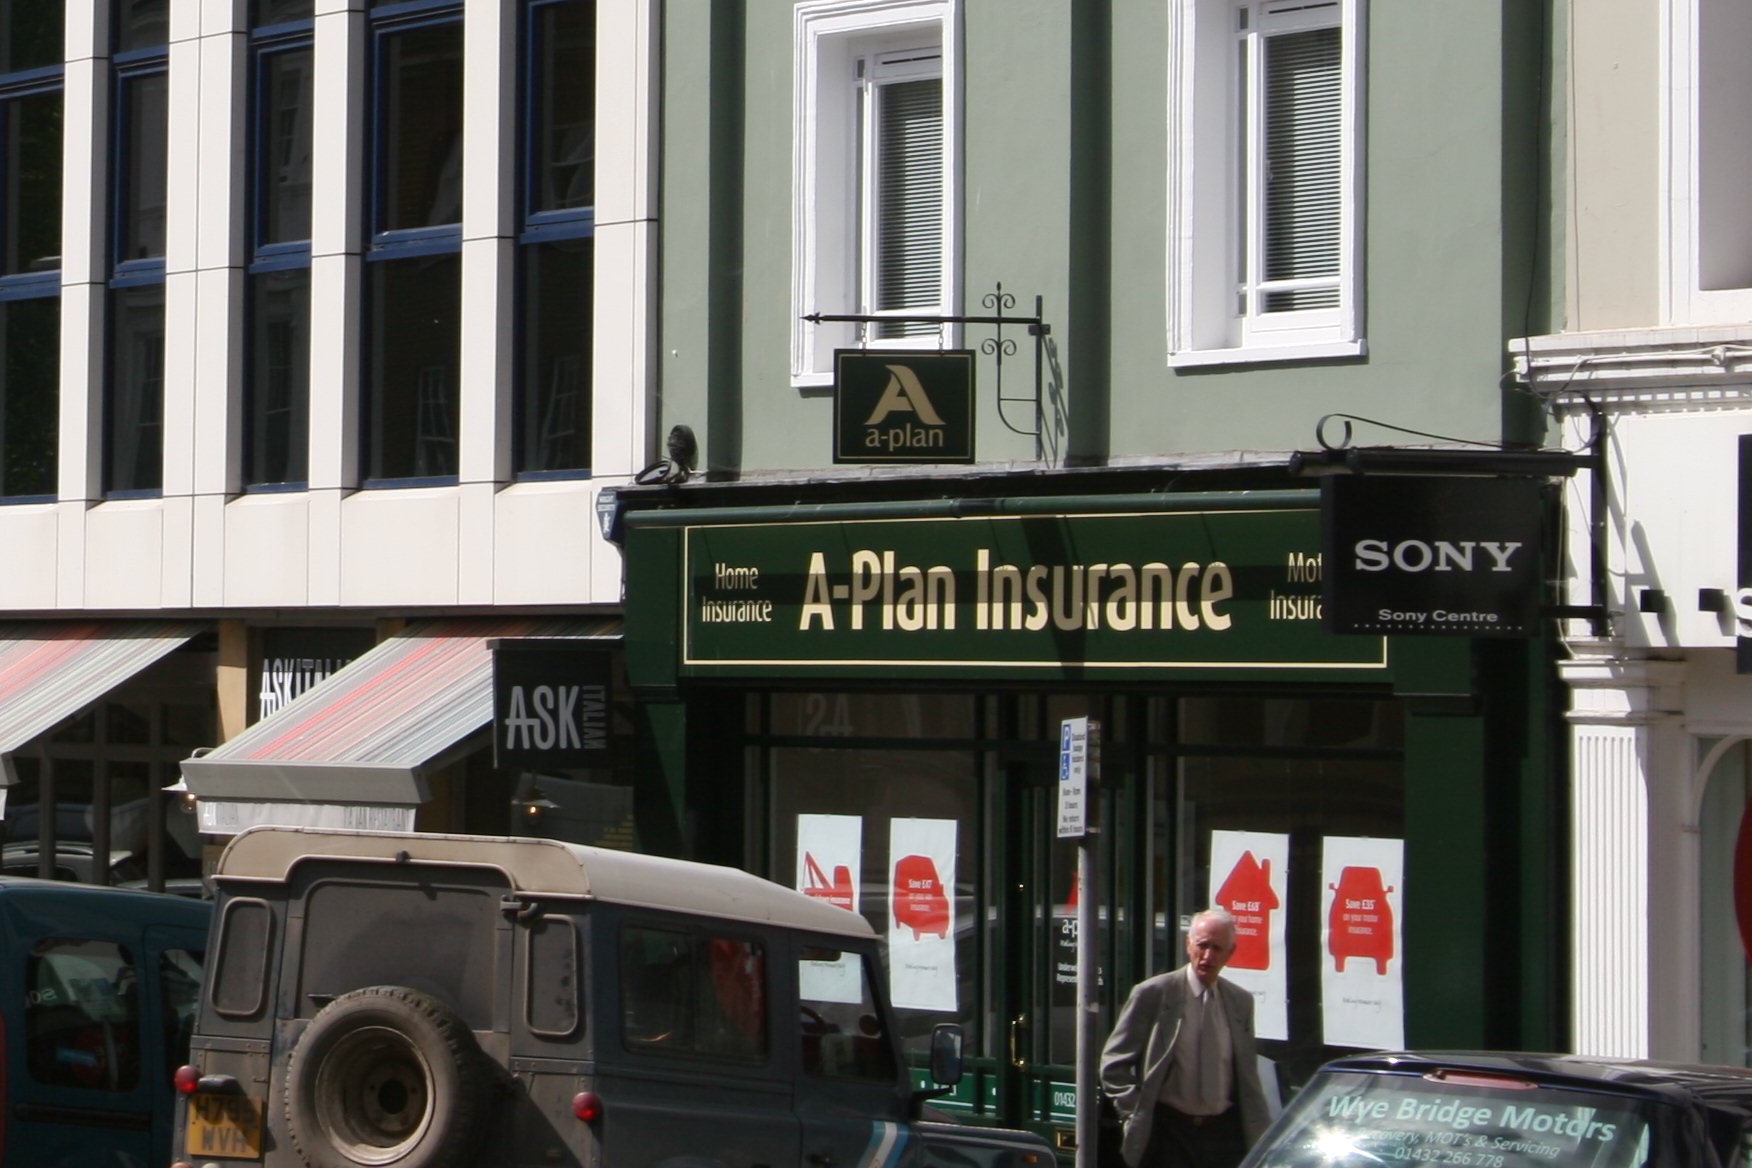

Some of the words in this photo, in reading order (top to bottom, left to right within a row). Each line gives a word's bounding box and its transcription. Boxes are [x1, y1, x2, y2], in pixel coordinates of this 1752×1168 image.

[864, 422, 945, 452] a-plan
[1287, 551, 1322, 583] Mot
[1354, 538, 1522, 573] SONY
[714, 562, 759, 590] Home
[798, 548, 957, 631] A-Plan
[975, 548, 1234, 632] Insurance
[701, 595, 773, 623] Insurance
[1377, 608, 1427, 624] Sony
[1432, 609, 1499, 623] Centre
[504, 684, 581, 750] ASK
[582, 684, 607, 750] ITALIAN
[908, 878, 921, 889] Save
[1232, 899, 1246, 911] Save
[1345, 898, 1360, 910] Save
[1328, 1095, 1390, 1124] Wye
[1396, 1096, 1493, 1130] Bridge
[1498, 1104, 1617, 1142] Motors
[1394, 1146, 1439, 1162] 01432
[1442, 1150, 1473, 1166] 266
[1475, 1153, 1505, 1168] 778
[1425, 1131, 1473, 1146] MOT's
[1474, 1134, 1489, 1149] &
[1490, 1136, 1561, 1160] Servicing
